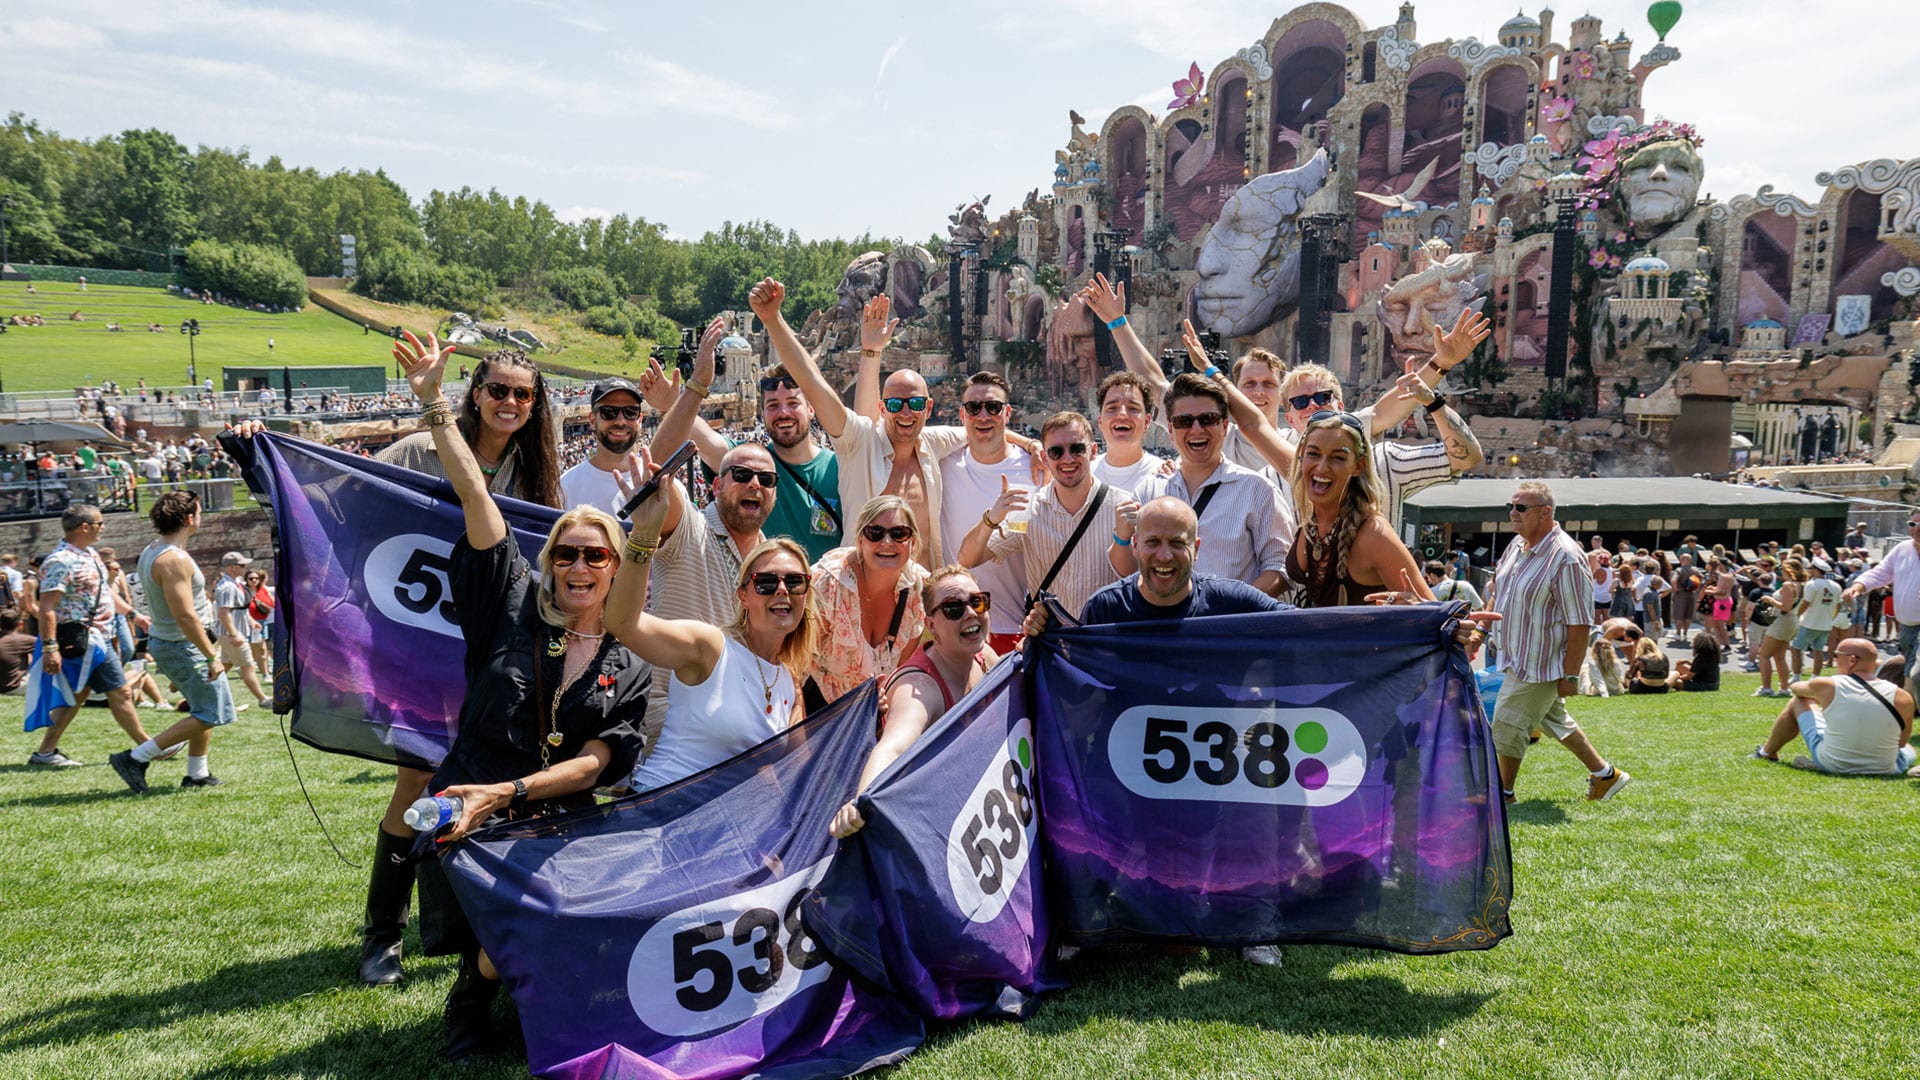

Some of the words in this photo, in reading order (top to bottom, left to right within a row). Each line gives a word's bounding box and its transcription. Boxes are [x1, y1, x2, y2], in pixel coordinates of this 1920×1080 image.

[1142, 717, 1290, 789] 538
[961, 759, 1033, 895] 538
[673, 887, 827, 1012] 538
